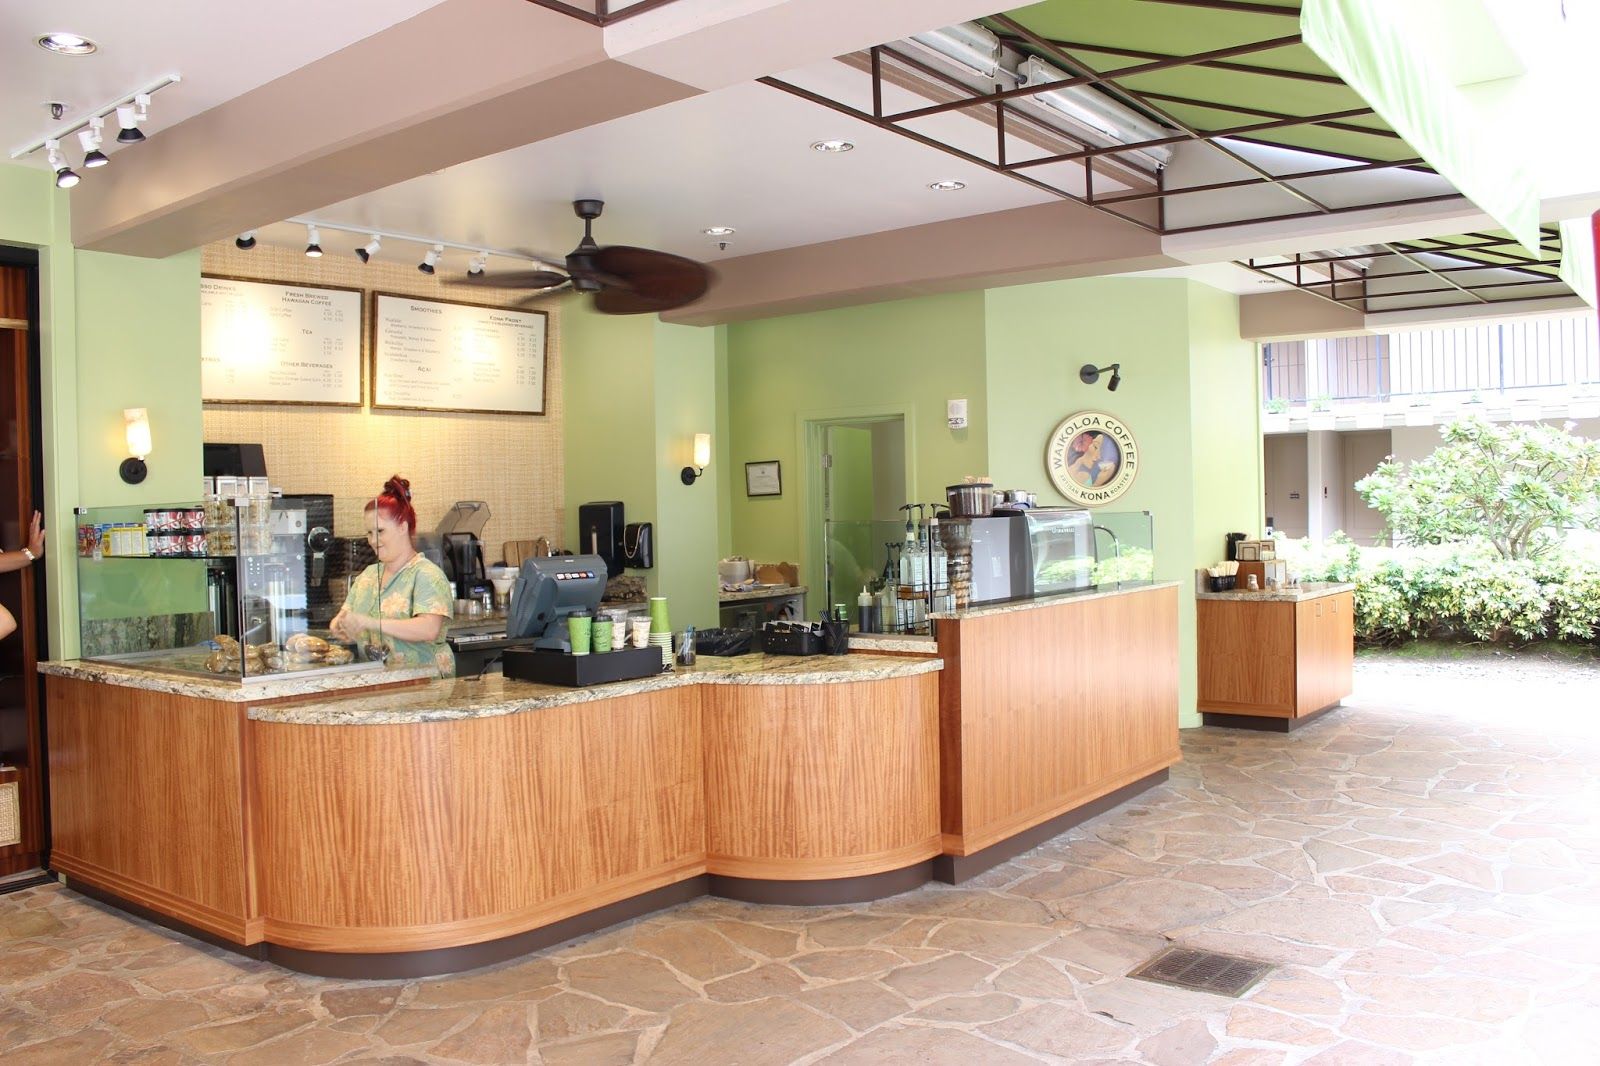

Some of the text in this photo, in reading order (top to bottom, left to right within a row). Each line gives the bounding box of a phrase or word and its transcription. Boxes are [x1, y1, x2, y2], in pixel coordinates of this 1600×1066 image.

[304, 292, 329, 300] BREWED
[410, 305, 443, 314] SMOOTHIES
[1053, 417, 1135, 470] WAIKOLOA COFFEE
[1080, 491, 1111, 501] KONA
